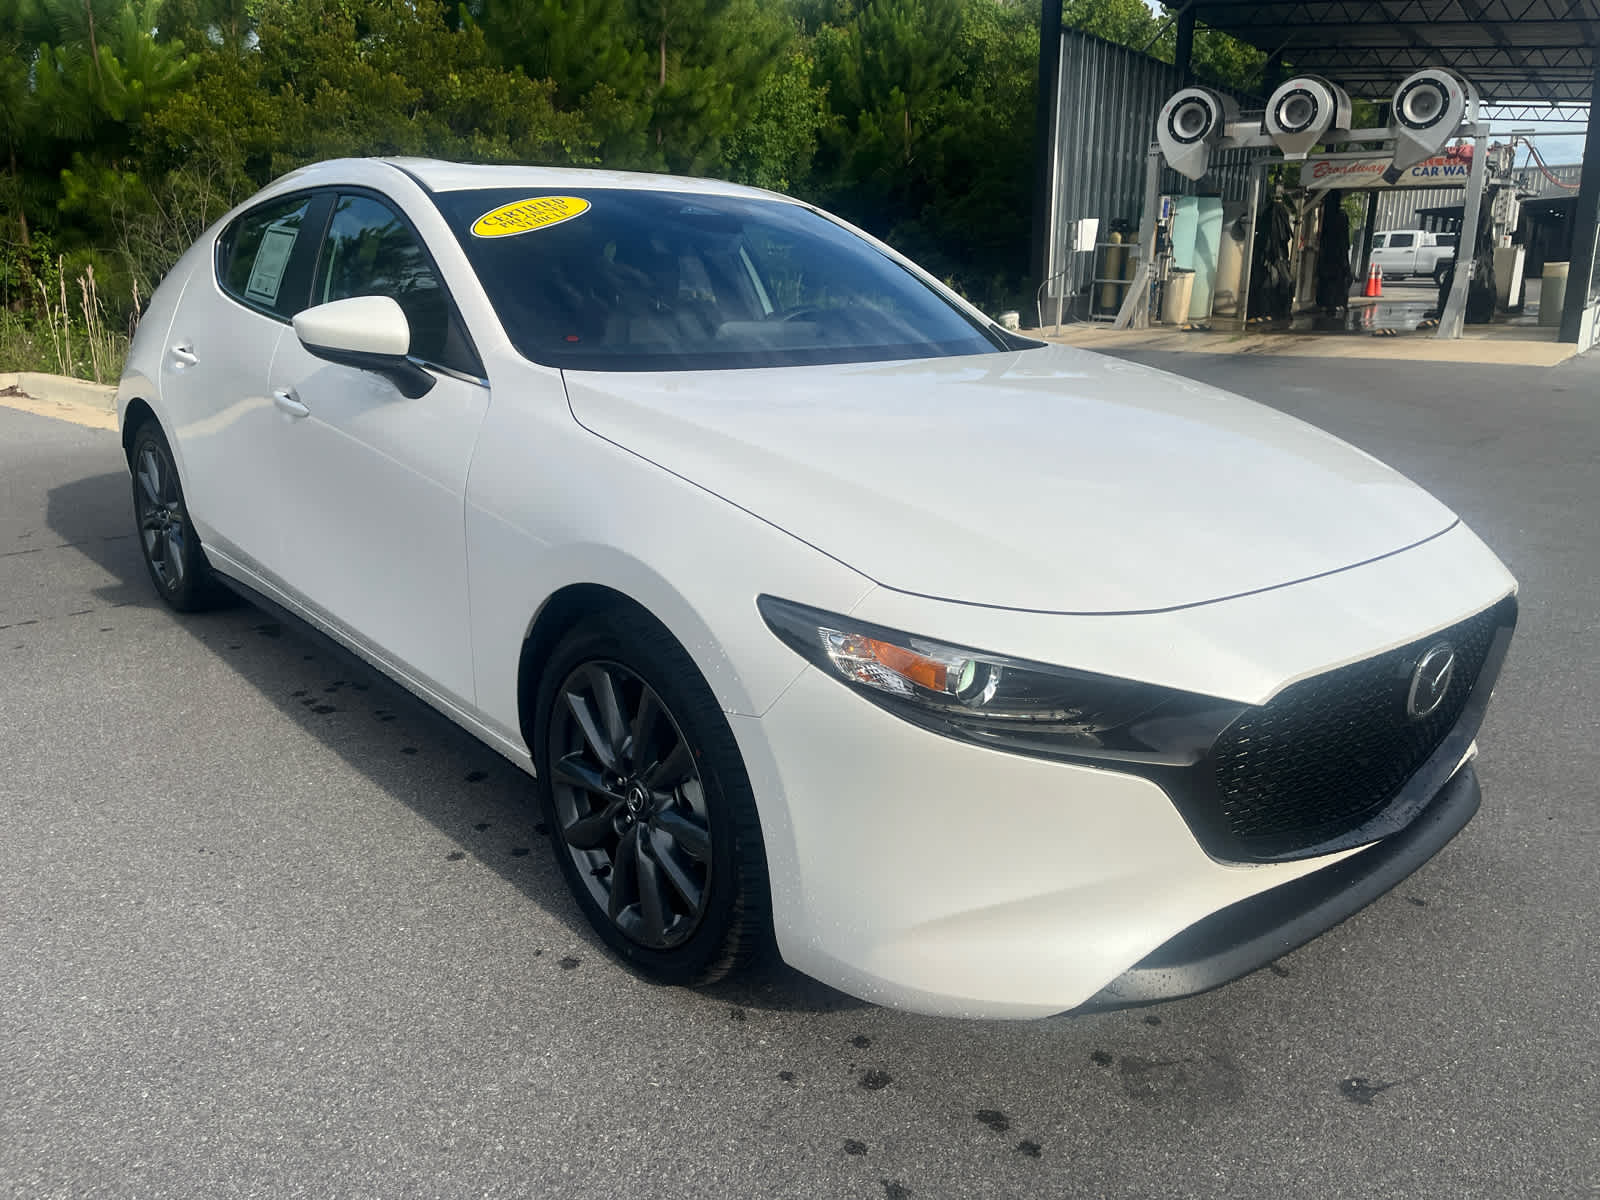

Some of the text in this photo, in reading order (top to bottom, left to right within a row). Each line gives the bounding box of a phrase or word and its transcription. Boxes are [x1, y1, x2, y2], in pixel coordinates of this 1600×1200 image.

[1312, 161, 1385, 178] Broadway
[1412, 166, 1439, 177] CAR
[483, 198, 565, 226] CERTIFIED
